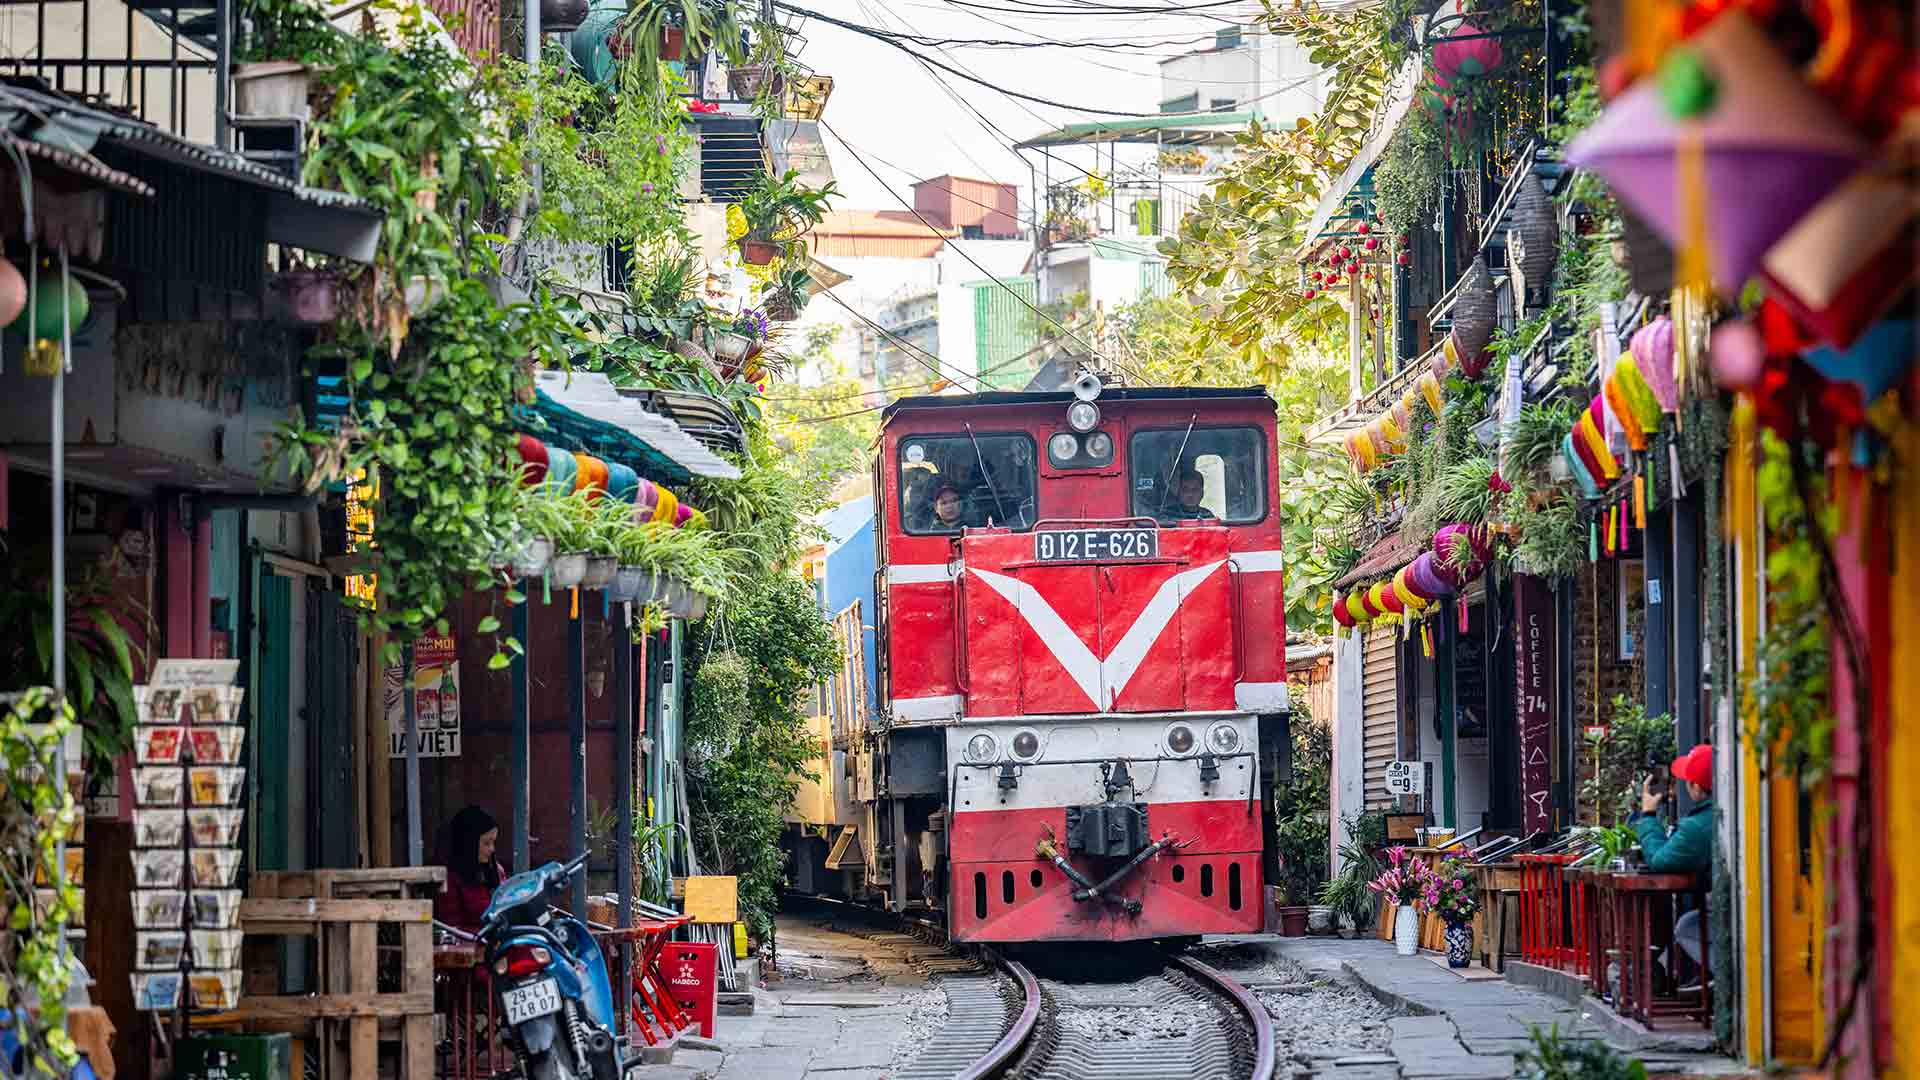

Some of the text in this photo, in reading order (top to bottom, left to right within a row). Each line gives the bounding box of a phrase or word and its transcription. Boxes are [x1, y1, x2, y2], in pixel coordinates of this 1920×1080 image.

[1529, 614, 1541, 688] COFFEE
[1526, 696, 1546, 713] 74
[671, 978, 700, 986] HABECO
